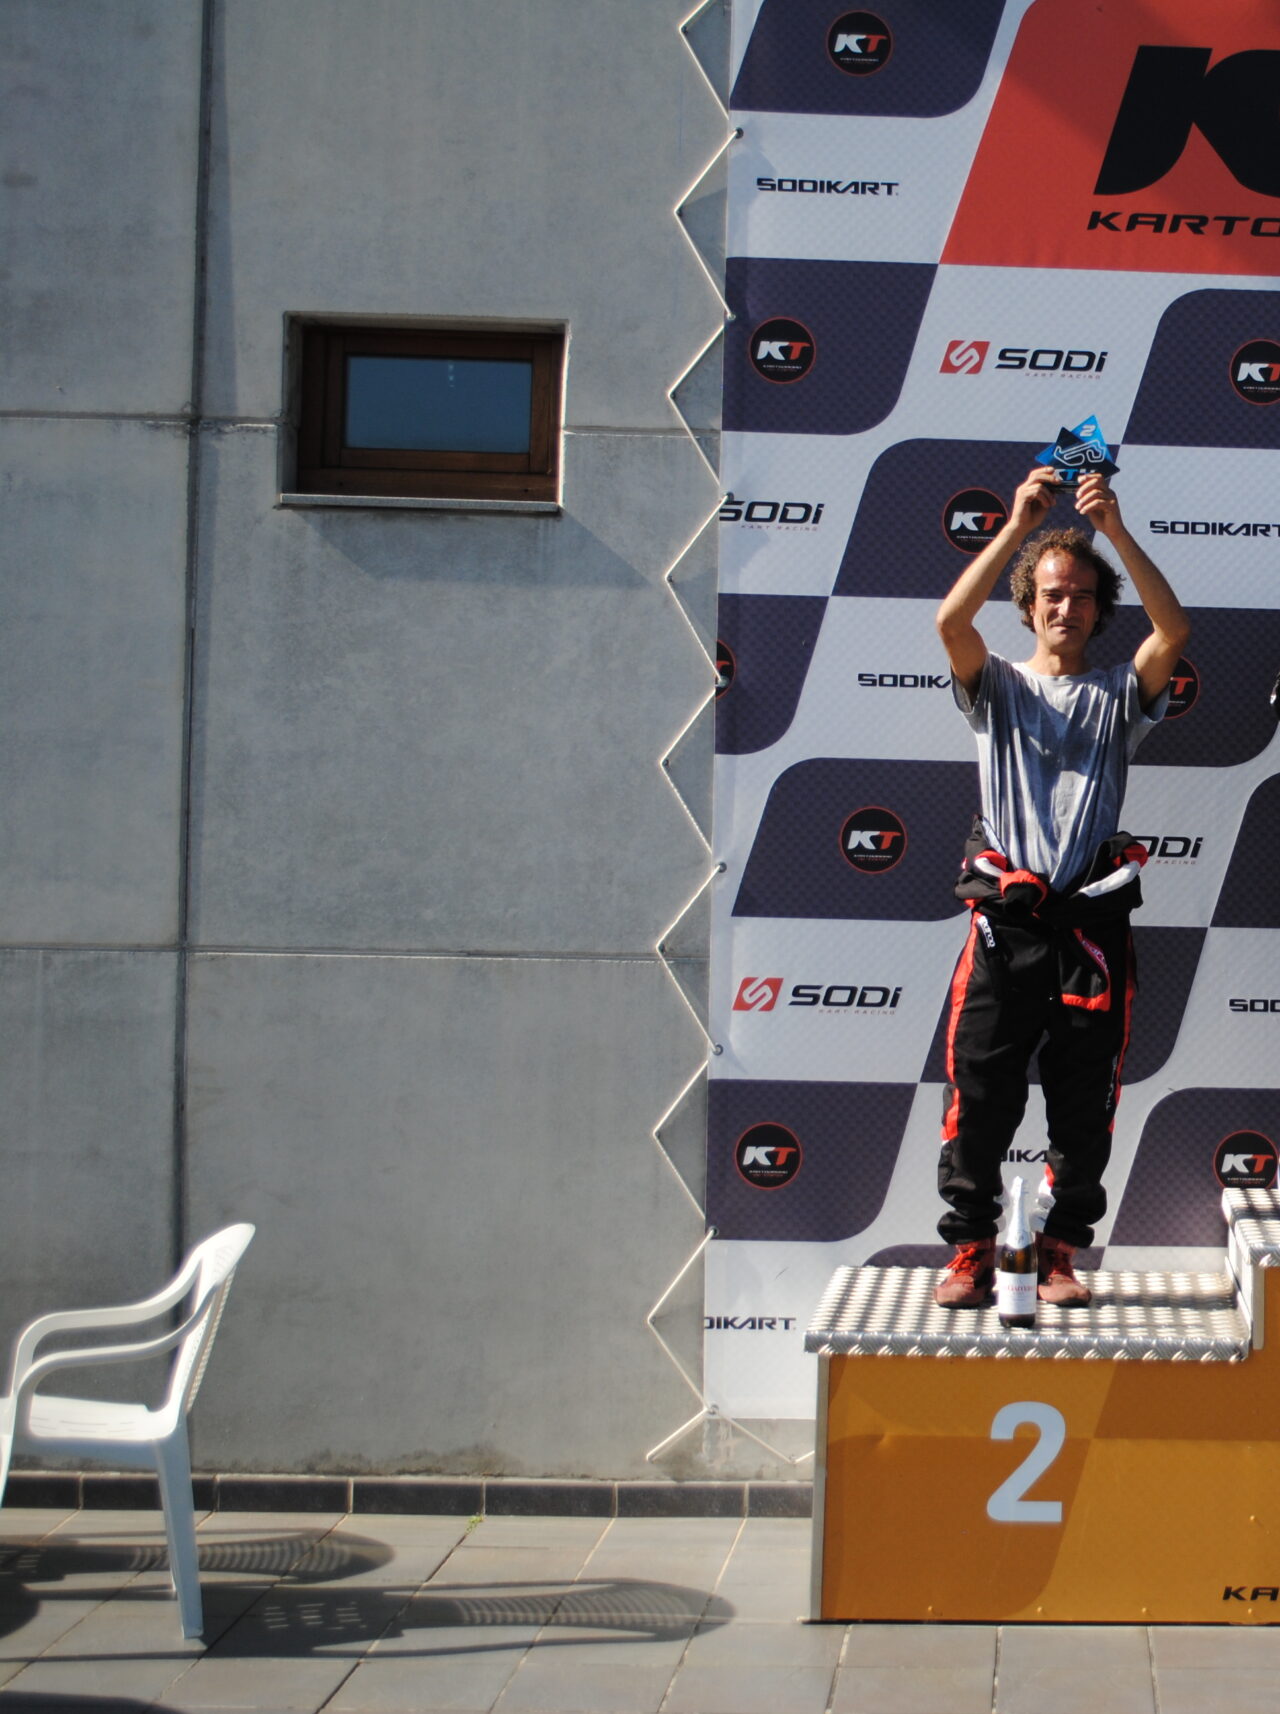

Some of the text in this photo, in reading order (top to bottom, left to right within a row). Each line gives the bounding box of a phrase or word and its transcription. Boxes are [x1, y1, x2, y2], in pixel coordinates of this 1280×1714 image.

[833, 34, 887, 53] KT
[757, 177, 899, 196] SODIKART
[757, 340, 809, 360] KT
[1080, 424, 1097, 437] 2
[950, 511, 1004, 531] KT
[847, 830, 902, 850] KT
[743, 1145, 797, 1166] KT
[1220, 1153, 1275, 1173] KT
[986, 1401, 1066, 1523] 2
